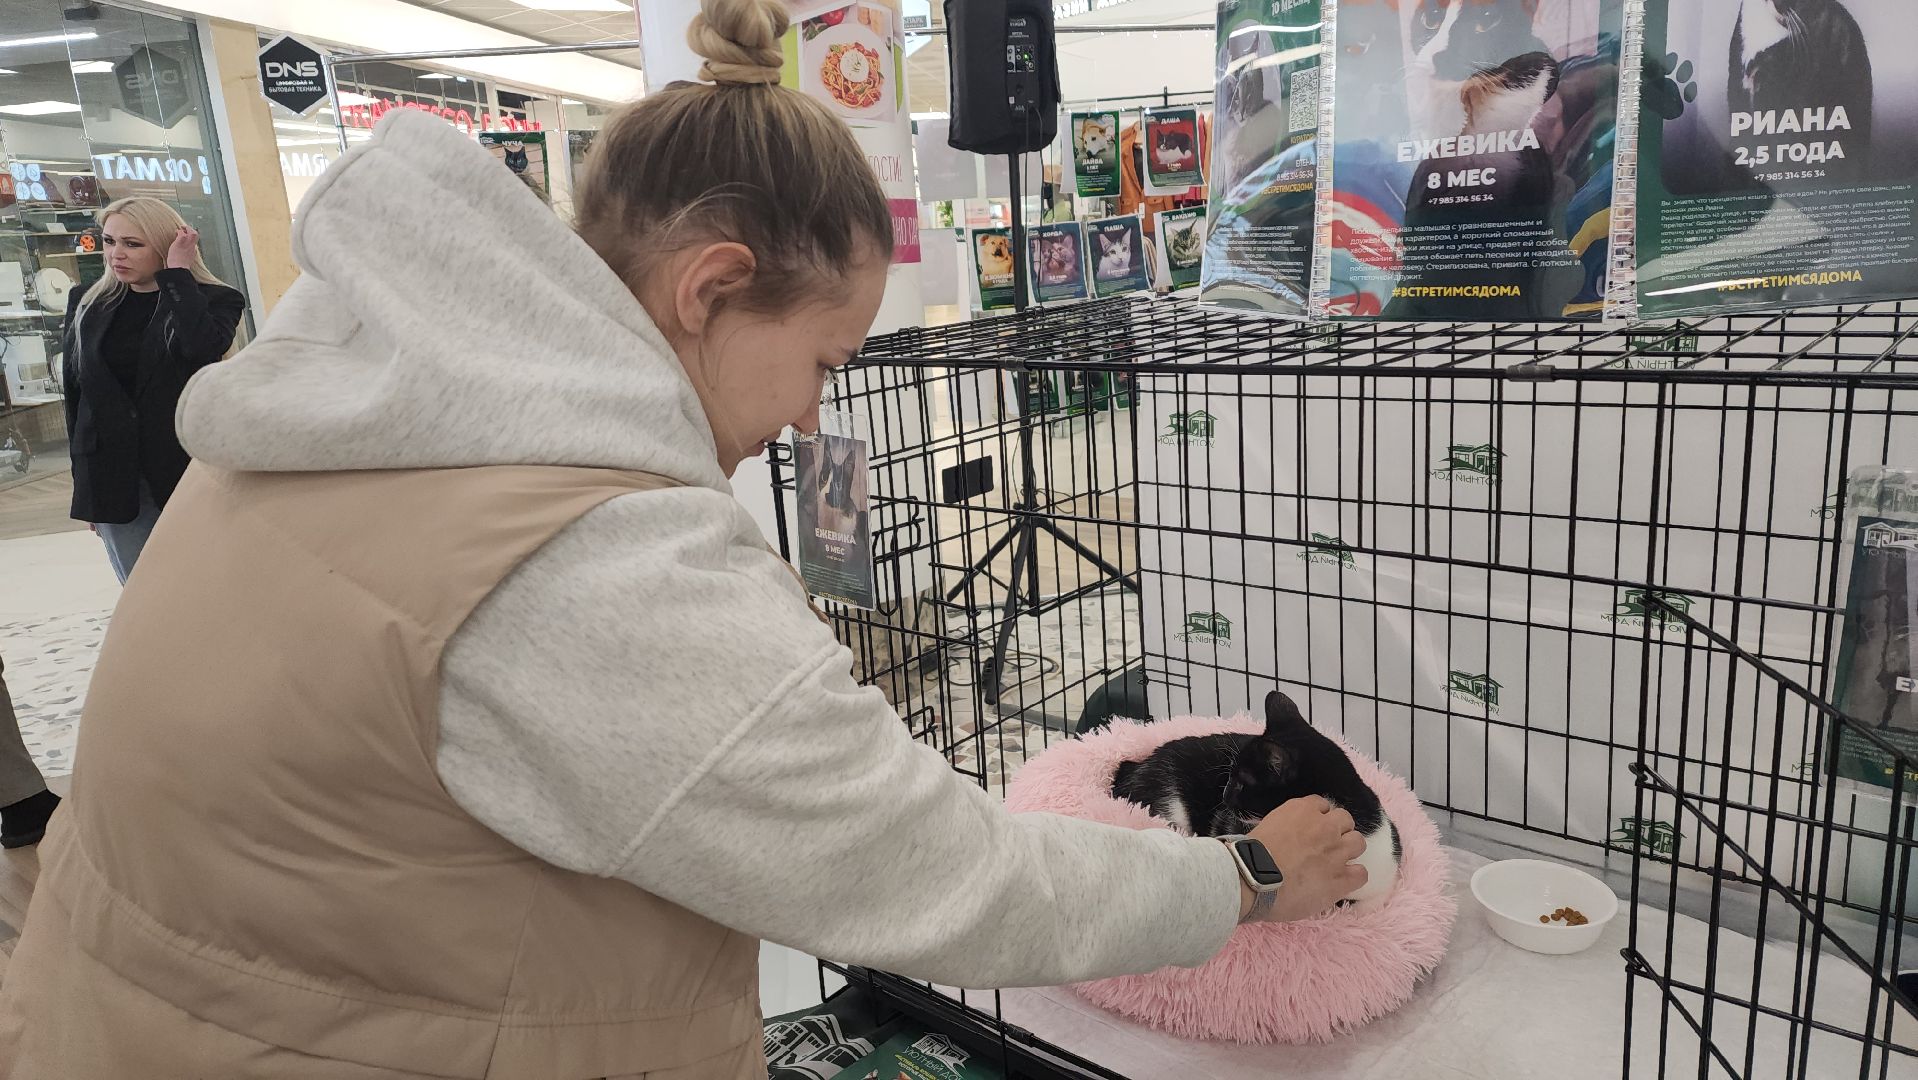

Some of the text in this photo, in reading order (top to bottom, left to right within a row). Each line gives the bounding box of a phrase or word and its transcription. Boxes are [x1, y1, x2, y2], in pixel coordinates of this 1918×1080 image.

[265, 61, 319, 78] DNS
[1730, 105, 1852, 137] РИАНА
[1396, 128, 1540, 163] ЕЖЕВИКА
[1734, 140, 1846, 168] 2,5 ГОДА
[1427, 167, 1497, 189] 8 МЕС
[1754, 169, 1826, 182] +7 985 314 56 34
[1428, 192, 1494, 206] +7 985 314 56 34
[1461, 231, 1500, 240] короткий
[1502, 228, 1553, 237] сломанный
[1535, 237, 1568, 246] особое
[1430, 251, 1462, 259] обожает
[1531, 248, 1578, 257] находится
[1425, 260, 1489, 271] Стерилизована,
[1491, 260, 1529, 269] привита.
[1391, 285, 1521, 299] #ВСТРЕТИМСЯДОМА
[815, 527, 857, 545] ЕЖЕВИКА
[830, 545, 845, 555] МЕС
[901, 1046, 945, 1073] УЮТНЫЙ
